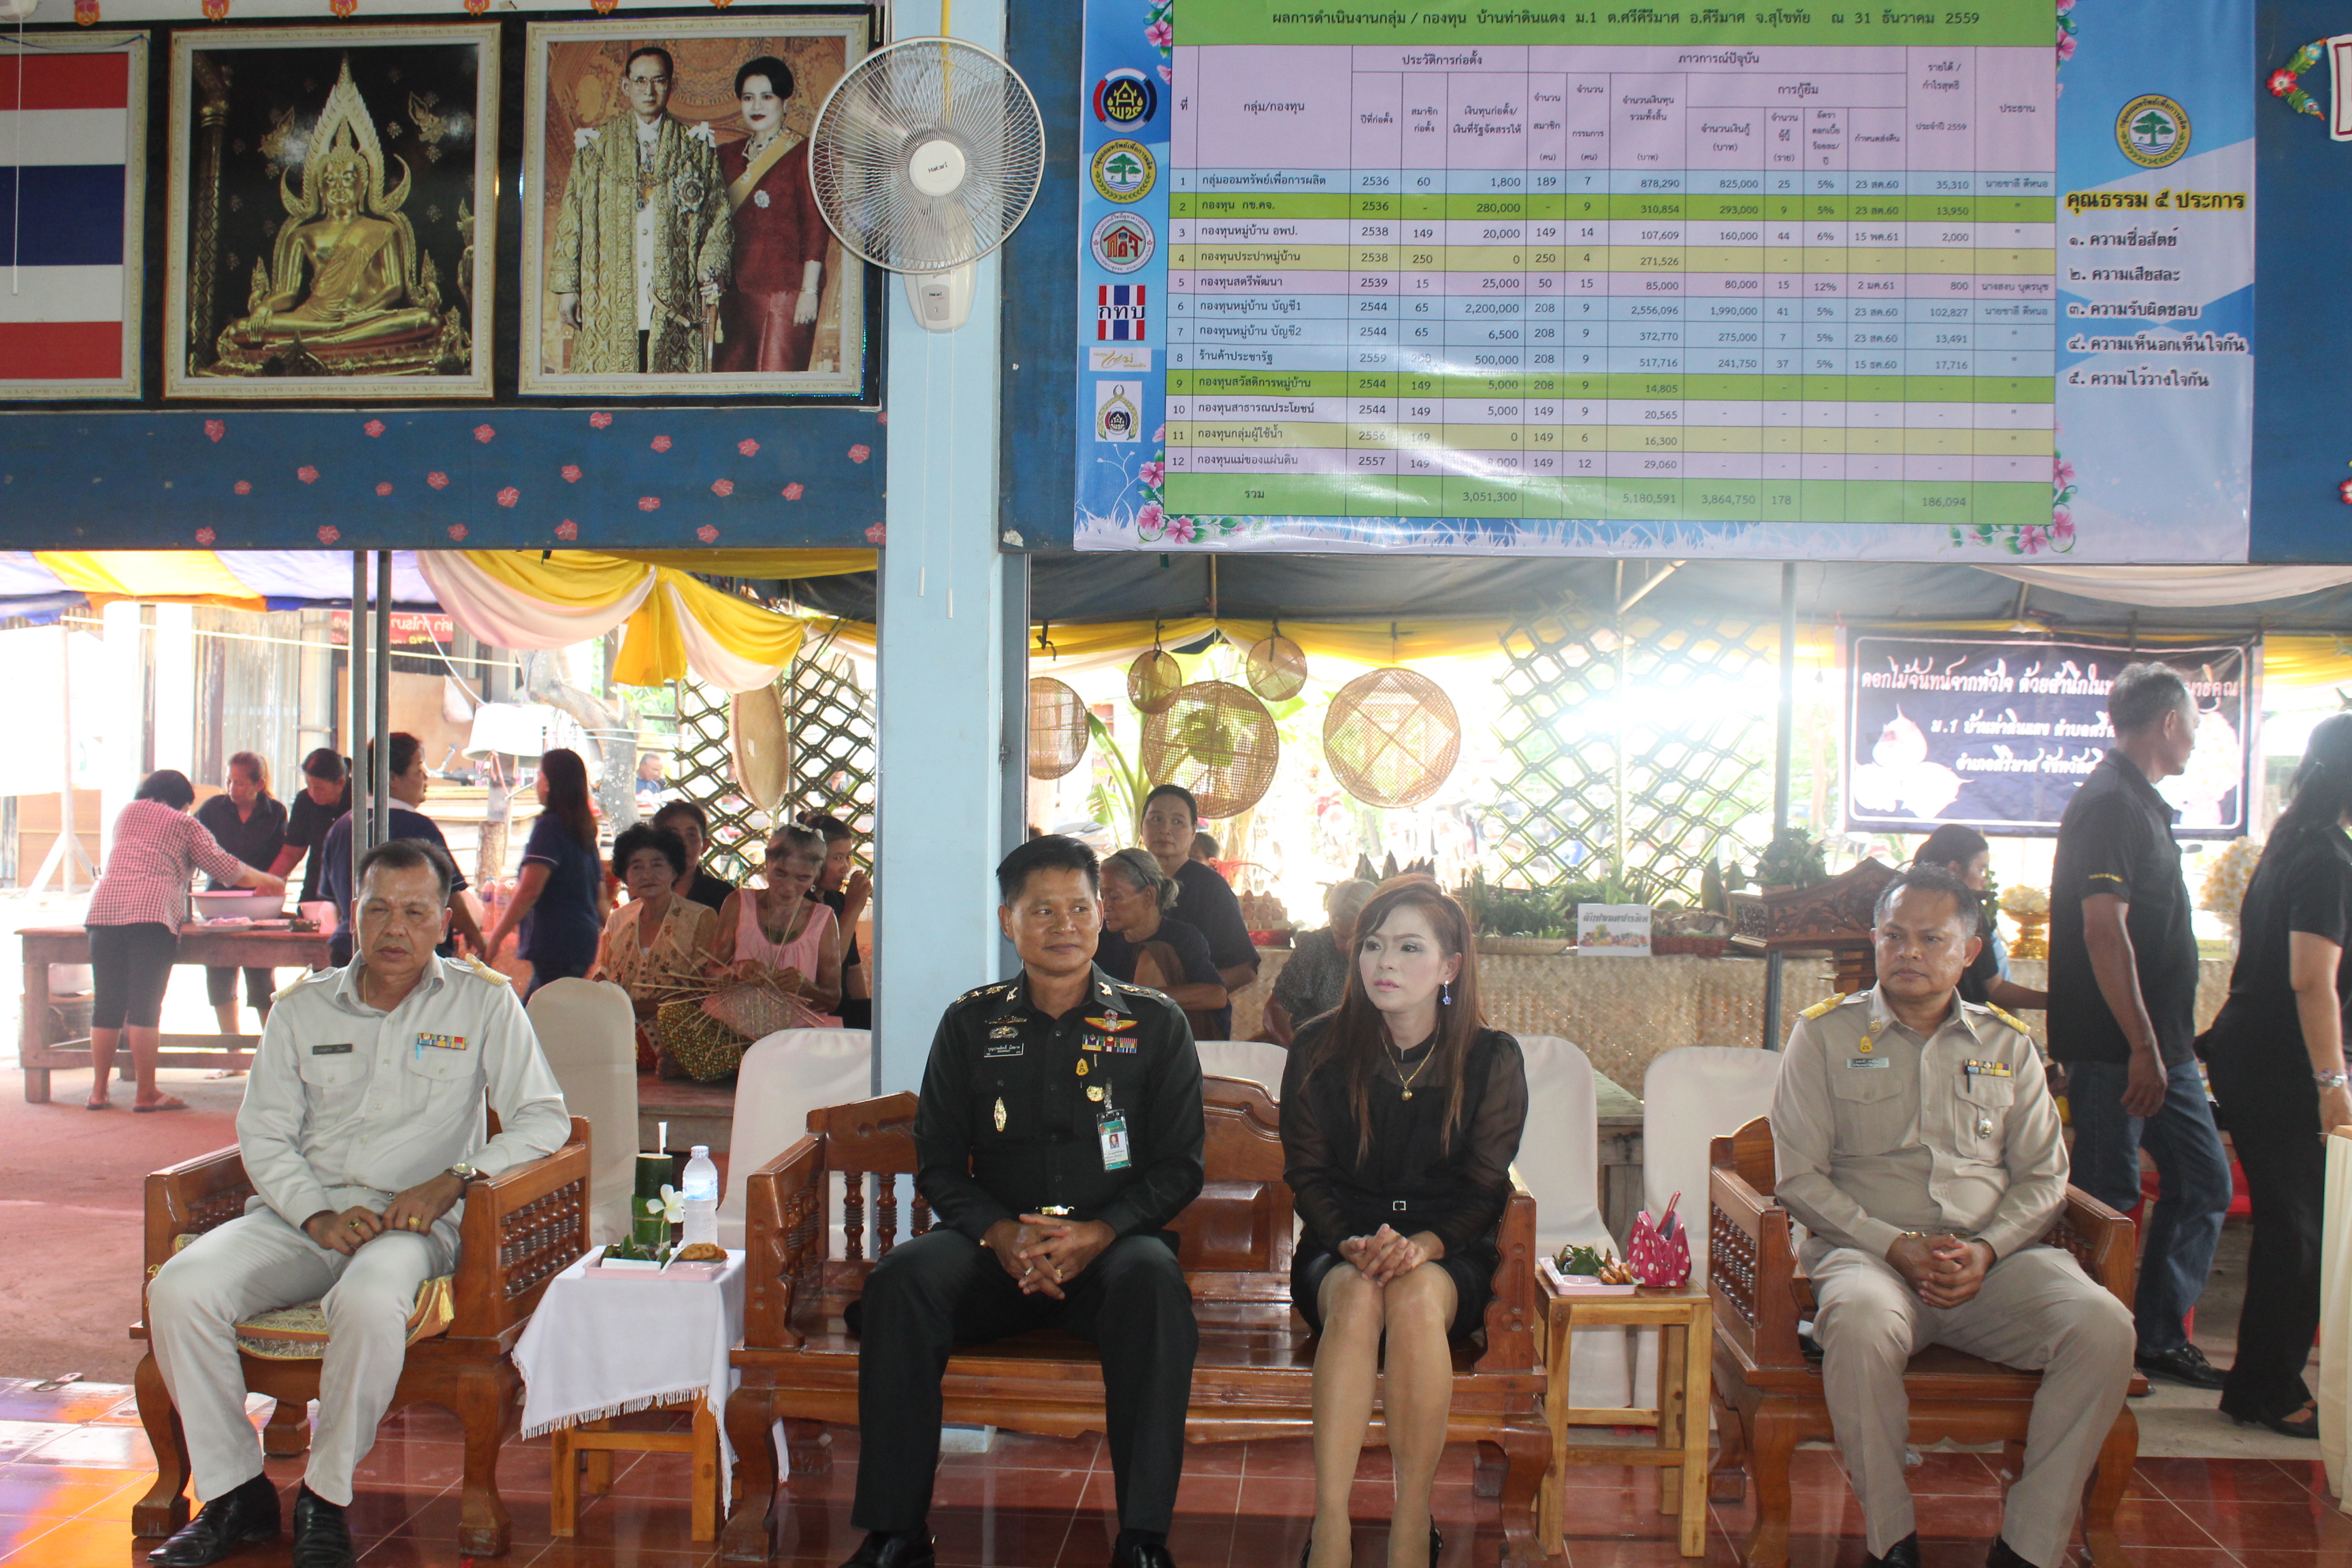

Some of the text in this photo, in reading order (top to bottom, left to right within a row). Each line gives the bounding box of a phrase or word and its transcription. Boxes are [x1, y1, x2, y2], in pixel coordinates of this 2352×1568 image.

[1273, 10, 1405, 28] ผลการดำเนินงานกลุ่ม
[1423, 14, 1466, 28] กองทุน
[1477, 9, 1565, 24] บ้านท่าดินแดง
[1575, 12, 1596, 23] ม.1
[1756, 8, 1810, 28] จ.สุโขทัย
[1832, 14, 1844, 23] ณ
[1855, 12, 1870, 24] 31
[1882, 9, 1934, 24] ธันวาคม
[1946, 12, 1979, 24] 2559
[1402, 50, 1482, 65] ประวัติการก่อตั้ง
[1244, 101, 1305, 115] กลุ่ม/กองทุน
[1411, 107, 1437, 115] สมาชิก
[1360, 112, 1392, 123] ปีที่ก่อตั้ง
[1414, 120, 1435, 132] ก่อตั้ง
[1533, 120, 1560, 129] สมาชิก
[1094, 142, 1153, 169] กลุ่มออมทรัพย์เพื่อการผลิต
[928, 161, 948, 174] Hatari
[1203, 172, 1326, 187] กลุ่มออมทรัพย์เพื่อการผลิต
[1362, 176, 1389, 186] 2536
[1492, 178, 1520, 187] 1,800
[1537, 177, 1556, 186] 189
[1641, 180, 1680, 188] 878,290
[1720, 180, 1759, 189] 825,000
[1936, 181, 1969, 189] 35,310
[1203, 201, 1235, 212] กองทุน
[1362, 201, 1389, 211] 2536
[2068, 194, 2147, 214] คุณธรรม
[2176, 192, 2244, 208] ประการ
[1477, 203, 1520, 214] 280,000
[1642, 205, 1680, 214] 310,854
[1720, 206, 1759, 215] 293,000
[1938, 207, 1969, 216] 13,950
[1202, 224, 1297, 238] กองทุนหมู่บ้าน อพป.
[1362, 227, 1388, 236] 2538
[1414, 229, 1433, 238] 149
[1483, 229, 1520, 240] 20,000
[1537, 228, 1556, 237] 149
[1642, 231, 1679, 240] 107,609
[1720, 232, 1758, 241] 160,000
[1942, 233, 1969, 242] 2,000
[2070, 227, 2178, 246] ๑. ความซื่อสัตย์
[1201, 250, 1300, 265] กองทุนประปาหมู่บ้าน
[1361, 253, 1388, 262] 2538
[1413, 255, 1433, 263] 250
[1640, 257, 1679, 266] 271,526
[2093, 266, 2180, 281] ความเสียสละ
[1201, 275, 1282, 289] กองทุนสตรีพัฒนา
[1361, 278, 1388, 287] 2539
[1482, 279, 1519, 289] 25,000
[1646, 282, 1679, 291] 85,000
[1725, 280, 1757, 289] 80,000
[1950, 282, 1968, 290] 800
[1200, 299, 1301, 314] กองทุนหมู่บ้าน บัญชี1
[1360, 302, 1387, 311] 2544
[1465, 304, 1519, 314] 2,200,000
[1631, 306, 1678, 315] 2,556,096
[1711, 307, 1757, 316] 1,990,000
[2091, 301, 2198, 316] ความรับผิดชอบ
[1098, 306, 1145, 320] กทบ
[1931, 308, 1968, 317] 102,827
[1200, 325, 1301, 339] กองทุนหมู่บ้าน บัญชี2
[1360, 327, 1387, 336] 2544
[1488, 330, 1519, 340] 6,500
[1640, 332, 1678, 342] 372,770
[1718, 333, 1757, 342] 275,000
[1936, 335, 1967, 344] 13,491
[2091, 335, 2244, 351] ความเห็นอกเห็นใจกัน
[1200, 349, 1273, 365] ร้านค้าประชารัฐ
[1360, 354, 1386, 363] 2559
[1475, 355, 1518, 365] 500,000
[1640, 359, 1678, 368] 517,716
[1718, 359, 1757, 368] 241,750
[1936, 361, 1967, 370] 17,716
[2091, 367, 2209, 386] ความไว้วางใจกัน
[1199, 375, 1311, 391] กองทุนสวัสดิการหมู่บ้าน
[1360, 379, 1386, 388] 2544
[1412, 381, 1431, 390] 149
[1488, 380, 1518, 390] 5,000
[1646, 385, 1678, 393] 14,805
[1198, 402, 1314, 415] กองทุนสาธารณประโยชน์
[1359, 405, 1386, 414] 2544
[1412, 407, 1431, 416] 149
[1488, 406, 1518, 416] 5,000
[1645, 410, 1678, 420] 20,565
[1198, 424, 1282, 442] กองทุนกลุ่มผู้ใช้น้ำ
[1646, 437, 1677, 446] 16,300
[1198, 454, 1298, 467] กองทุนแม่ของแผ่นดิน
[1358, 457, 1385, 466] 2557
[1644, 460, 1677, 470] 29,060
[1463, 492, 1517, 502] 3,051,300
[1623, 493, 1676, 504] 5,180,591
[1701, 495, 1755, 506] 3,864,750
[1772, 495, 1791, 505] 178
[1923, 497, 1966, 508] 186,094
